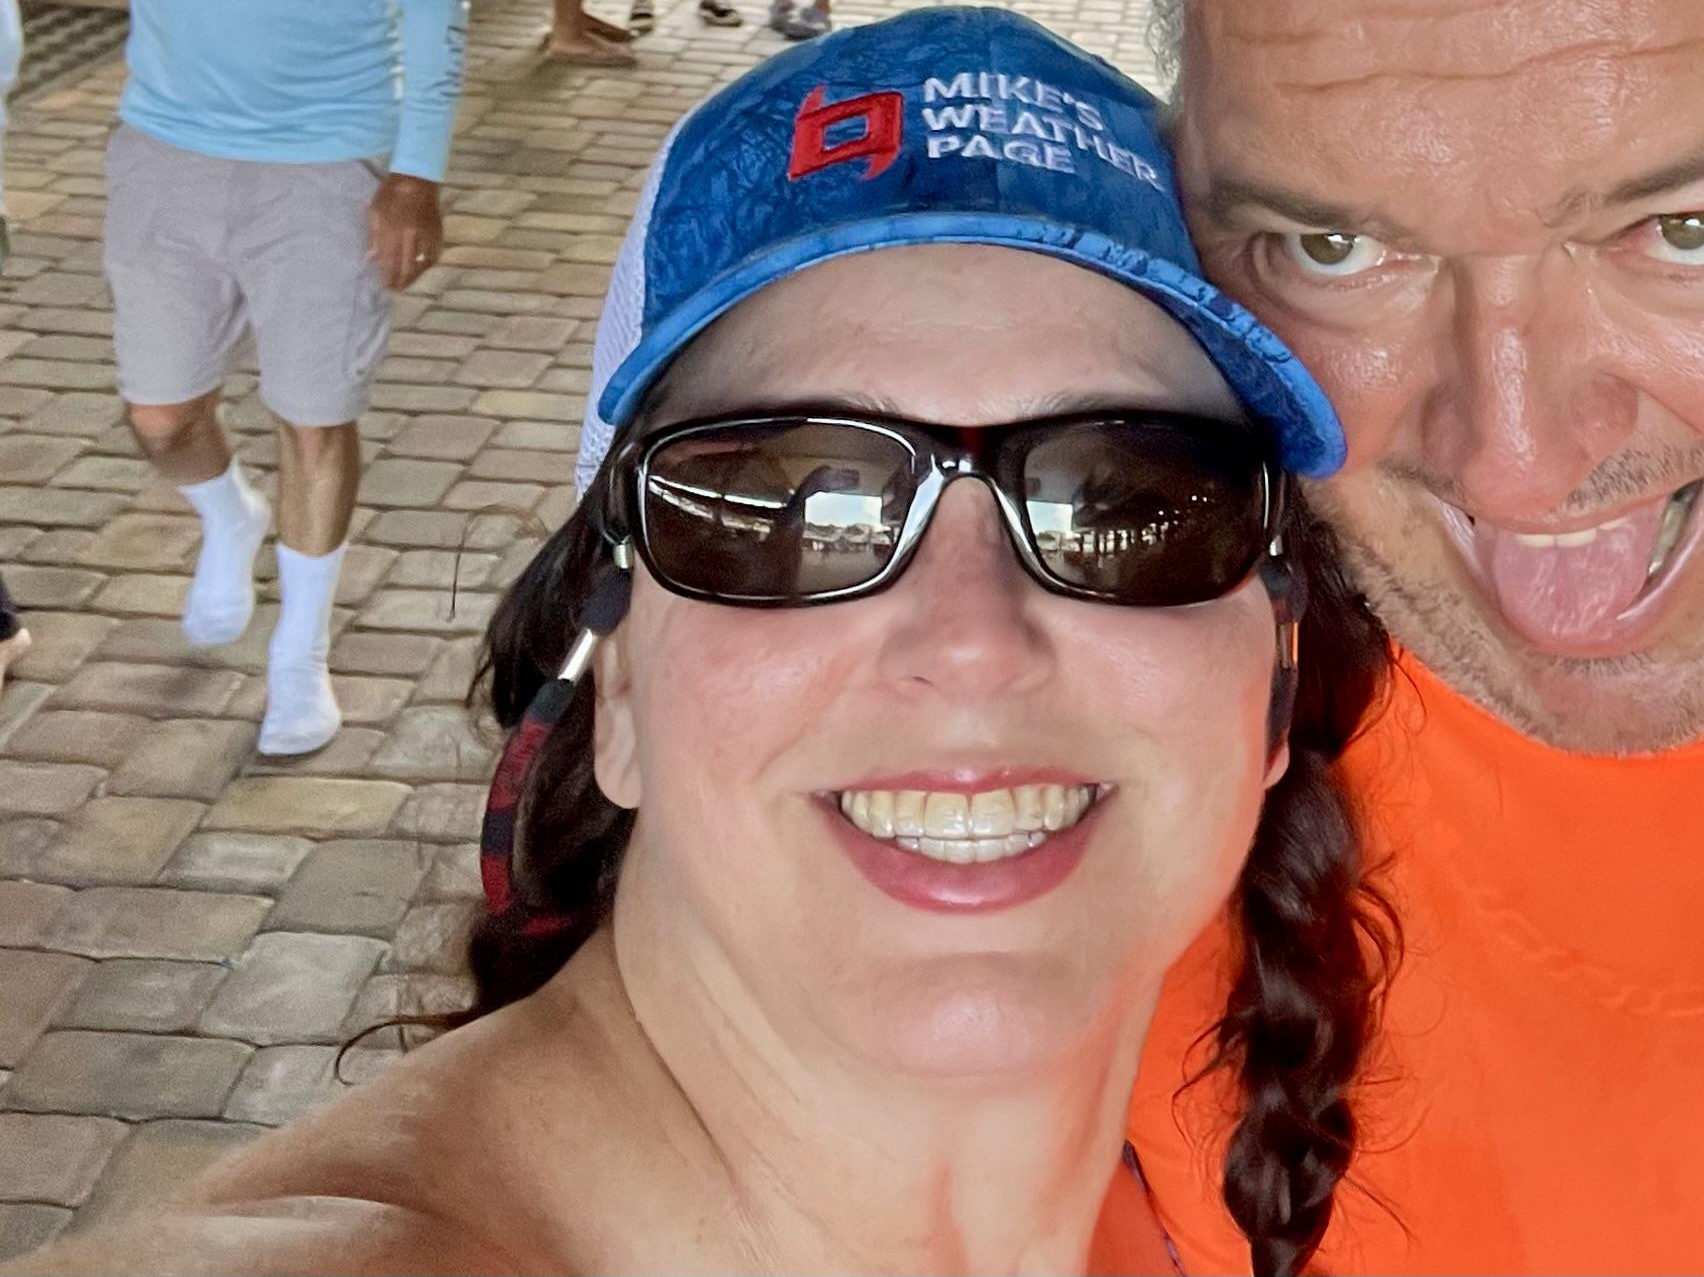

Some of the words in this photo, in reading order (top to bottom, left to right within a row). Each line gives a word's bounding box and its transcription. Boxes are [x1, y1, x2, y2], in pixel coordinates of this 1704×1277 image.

[923, 72, 1104, 131] MIKE'S
[921, 101, 1167, 193] WEATHER
[926, 134, 1076, 173] PAGE
